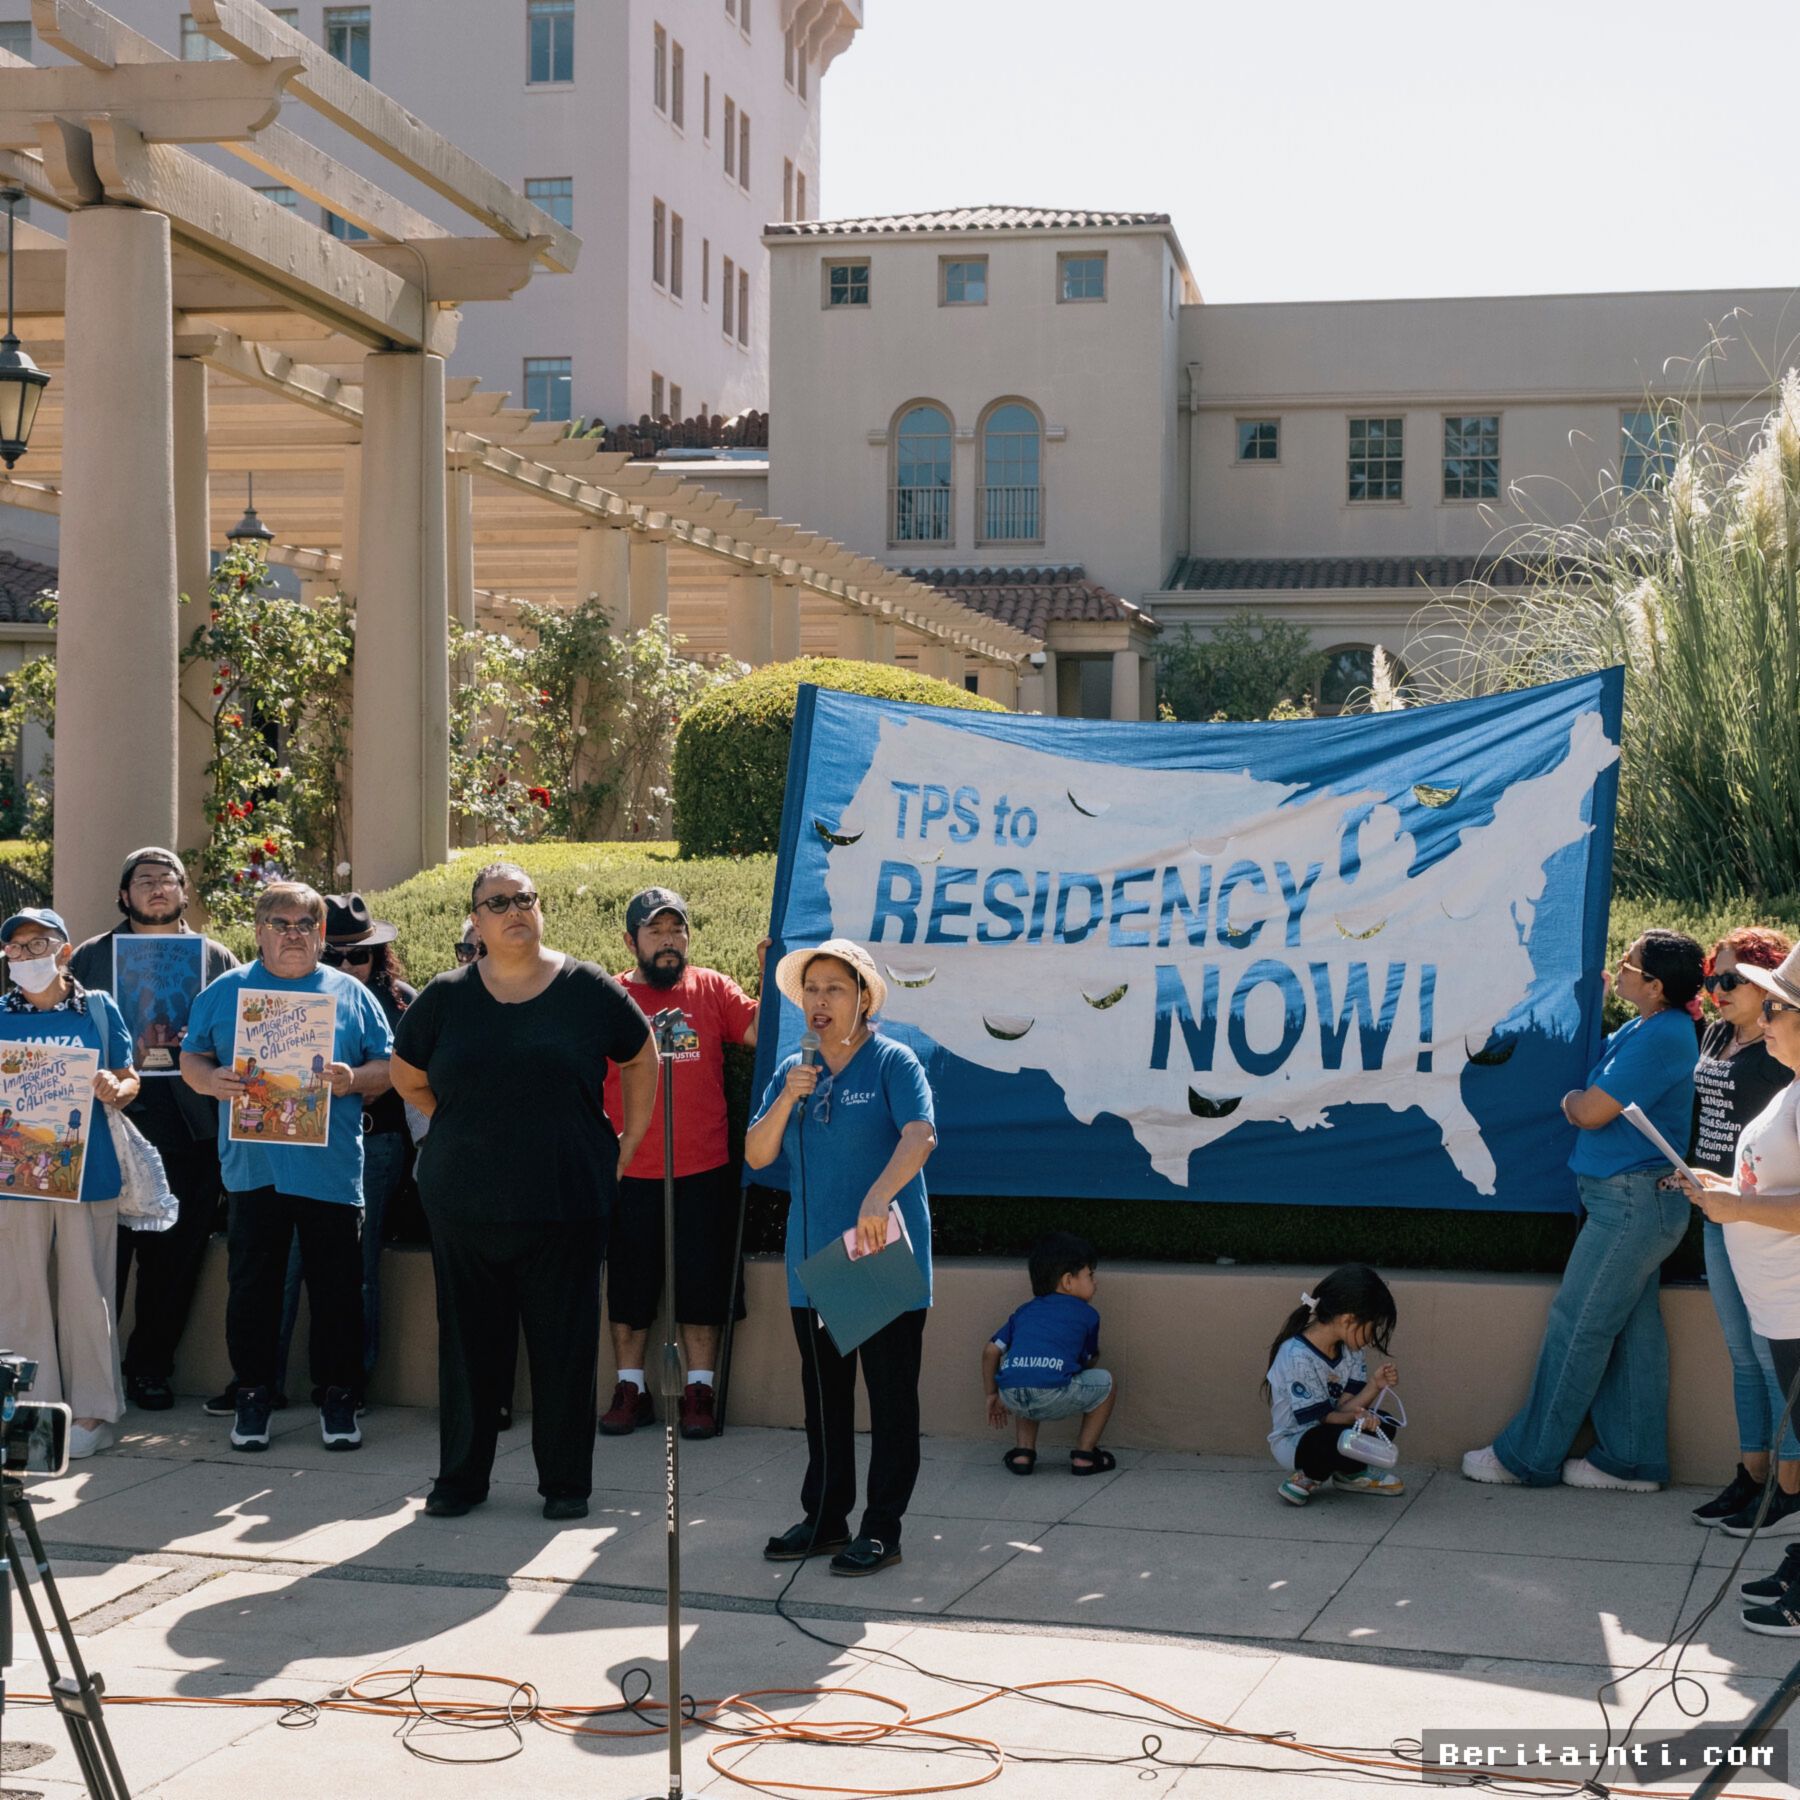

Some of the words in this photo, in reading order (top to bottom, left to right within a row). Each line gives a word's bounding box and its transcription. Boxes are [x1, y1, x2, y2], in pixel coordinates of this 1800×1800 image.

[891, 780, 981, 844] TPS
[993, 794, 1038, 848] to
[869, 859, 1324, 949] RESIDENCY
[246, 1006, 307, 1042] IMMIGRANTS
[263, 1022, 301, 1045] POWER
[1149, 959, 1437, 1076] NOW!
[260, 1029, 316, 1059] CALIFORNIA
[3, 1060, 67, 1093] IMMIGRANTS
[21, 1075, 60, 1098] POWER
[16, 1083, 75, 1112] CALIFORNIA
[1011, 1356, 1064, 1371] SALVADOR
[666, 1426, 675, 1533] ULTIMATE
